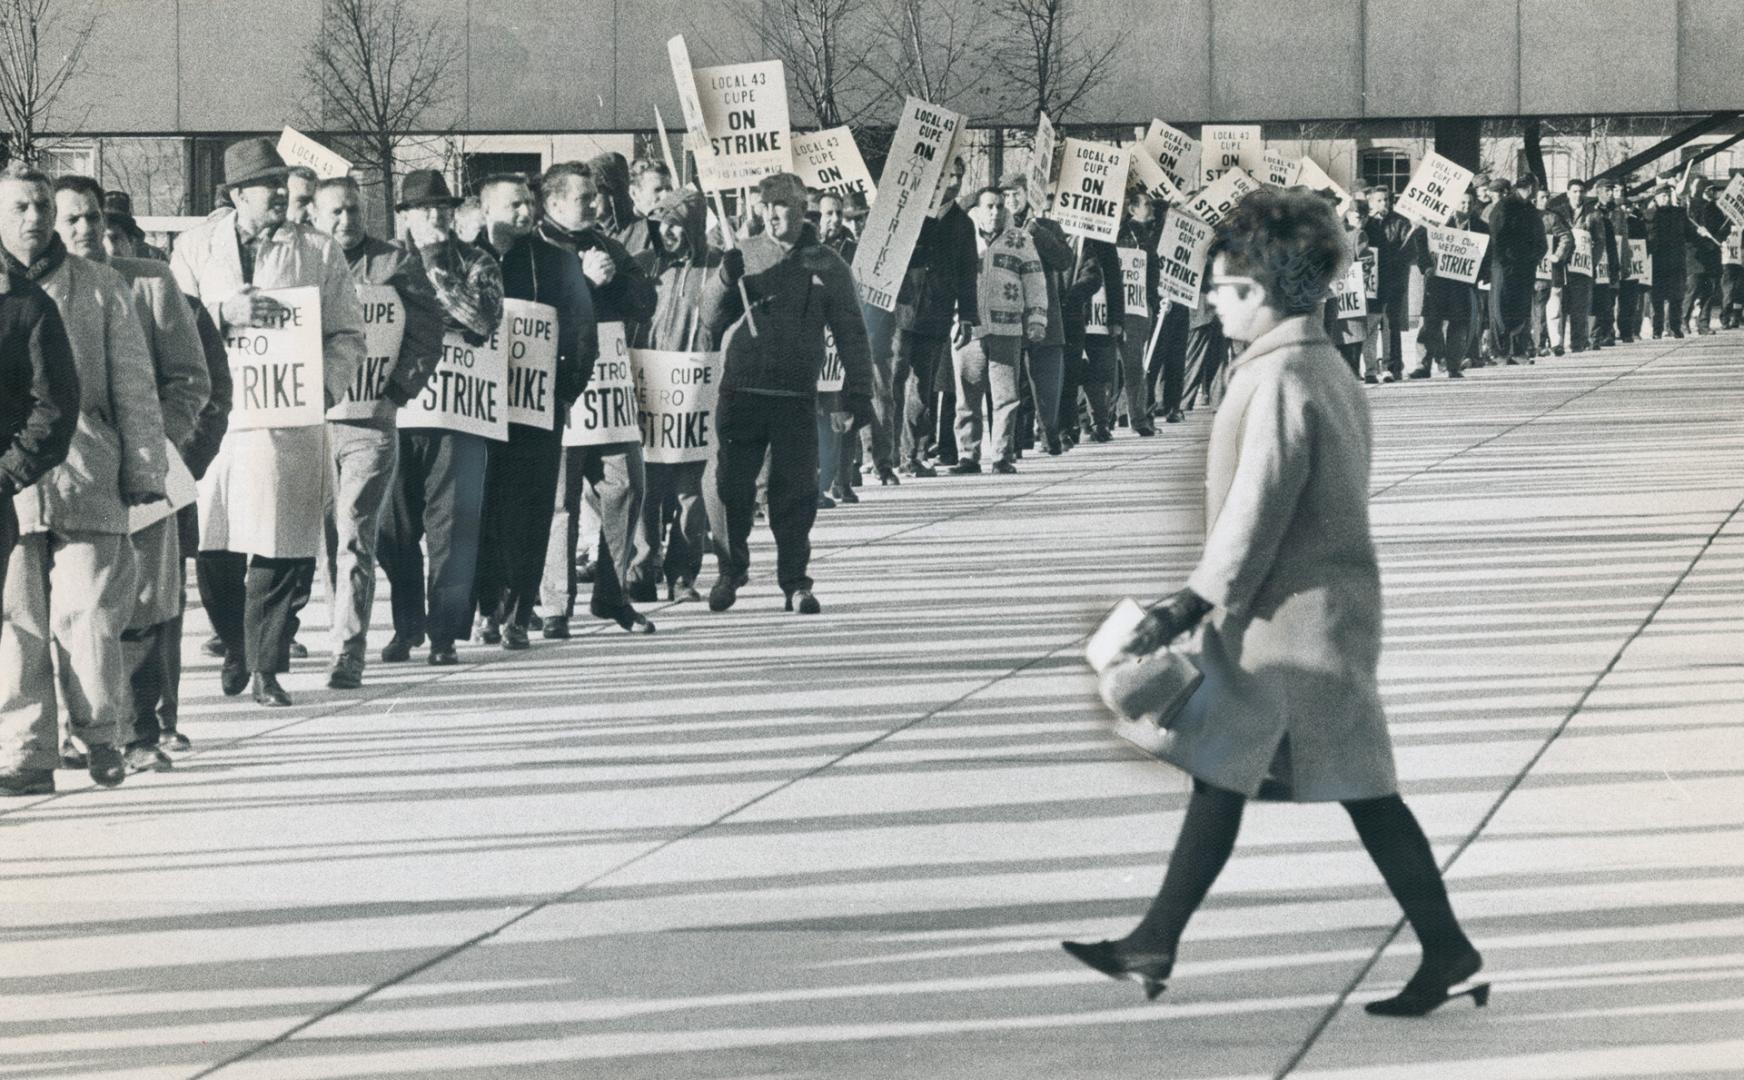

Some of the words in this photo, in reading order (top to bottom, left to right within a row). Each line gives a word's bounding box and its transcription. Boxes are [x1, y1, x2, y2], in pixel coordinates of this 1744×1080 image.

[711, 74, 749, 90] LOCAL
[751, 72, 766, 86] 43
[724, 89, 756, 105] CUPE
[728, 109, 756, 131] ON
[914, 107, 942, 129] LOCAL
[943, 117, 955, 132] 43
[918, 124, 943, 143] CUPE
[1160, 128, 1182, 147] LOCAL
[1183, 140, 1193, 152] 43
[1213, 130, 1236, 140] LOCAL
[1240, 130, 1250, 140] 43
[711, 131, 781, 156] STRIKE
[794, 141, 824, 156] LOCAL
[826, 136, 839, 148] 43
[913, 141, 936, 162] ON
[1163, 141, 1184, 157] CUPE
[1220, 141, 1241, 151] CUPE
[291, 142, 320, 169] LOCAL
[809, 151, 836, 166] CUPE
[1077, 147, 1105, 163] LOCAL
[1107, 154, 1120, 166] 43
[1158, 151, 1178, 170] ON
[1222, 153, 1240, 167] ON
[1263, 155, 1285, 167] LOCAL
[818, 165, 843, 184] ON
[1083, 161, 1109, 176] CUPE
[1431, 160, 1450, 176] LOCAL
[1081, 177, 1105, 196] ON
[1233, 177, 1250, 194] LOC
[1270, 173, 1286, 186] ON
[1427, 181, 1445, 197] ON
[1060, 192, 1117, 218] STRIKE
[1218, 200, 1231, 213] O
[1408, 187, 1449, 216] STRIKE
[1194, 199, 1220, 226] STR
[1175, 217, 1195, 235] LOCAL
[1196, 229, 1206, 241] 43
[1178, 231, 1197, 248] CUPE
[1174, 245, 1192, 265] ON
[1159, 255, 1198, 287] STRIKE
[1439, 253, 1476, 277] STRIKE
[364, 302, 395, 323] UPE
[512, 316, 553, 342] CUPE
[442, 344, 475, 369] TRO
[671, 366, 712, 385] CUPE
[243, 362, 306, 410] RIKE
[422, 370, 498, 424] STRIKE
